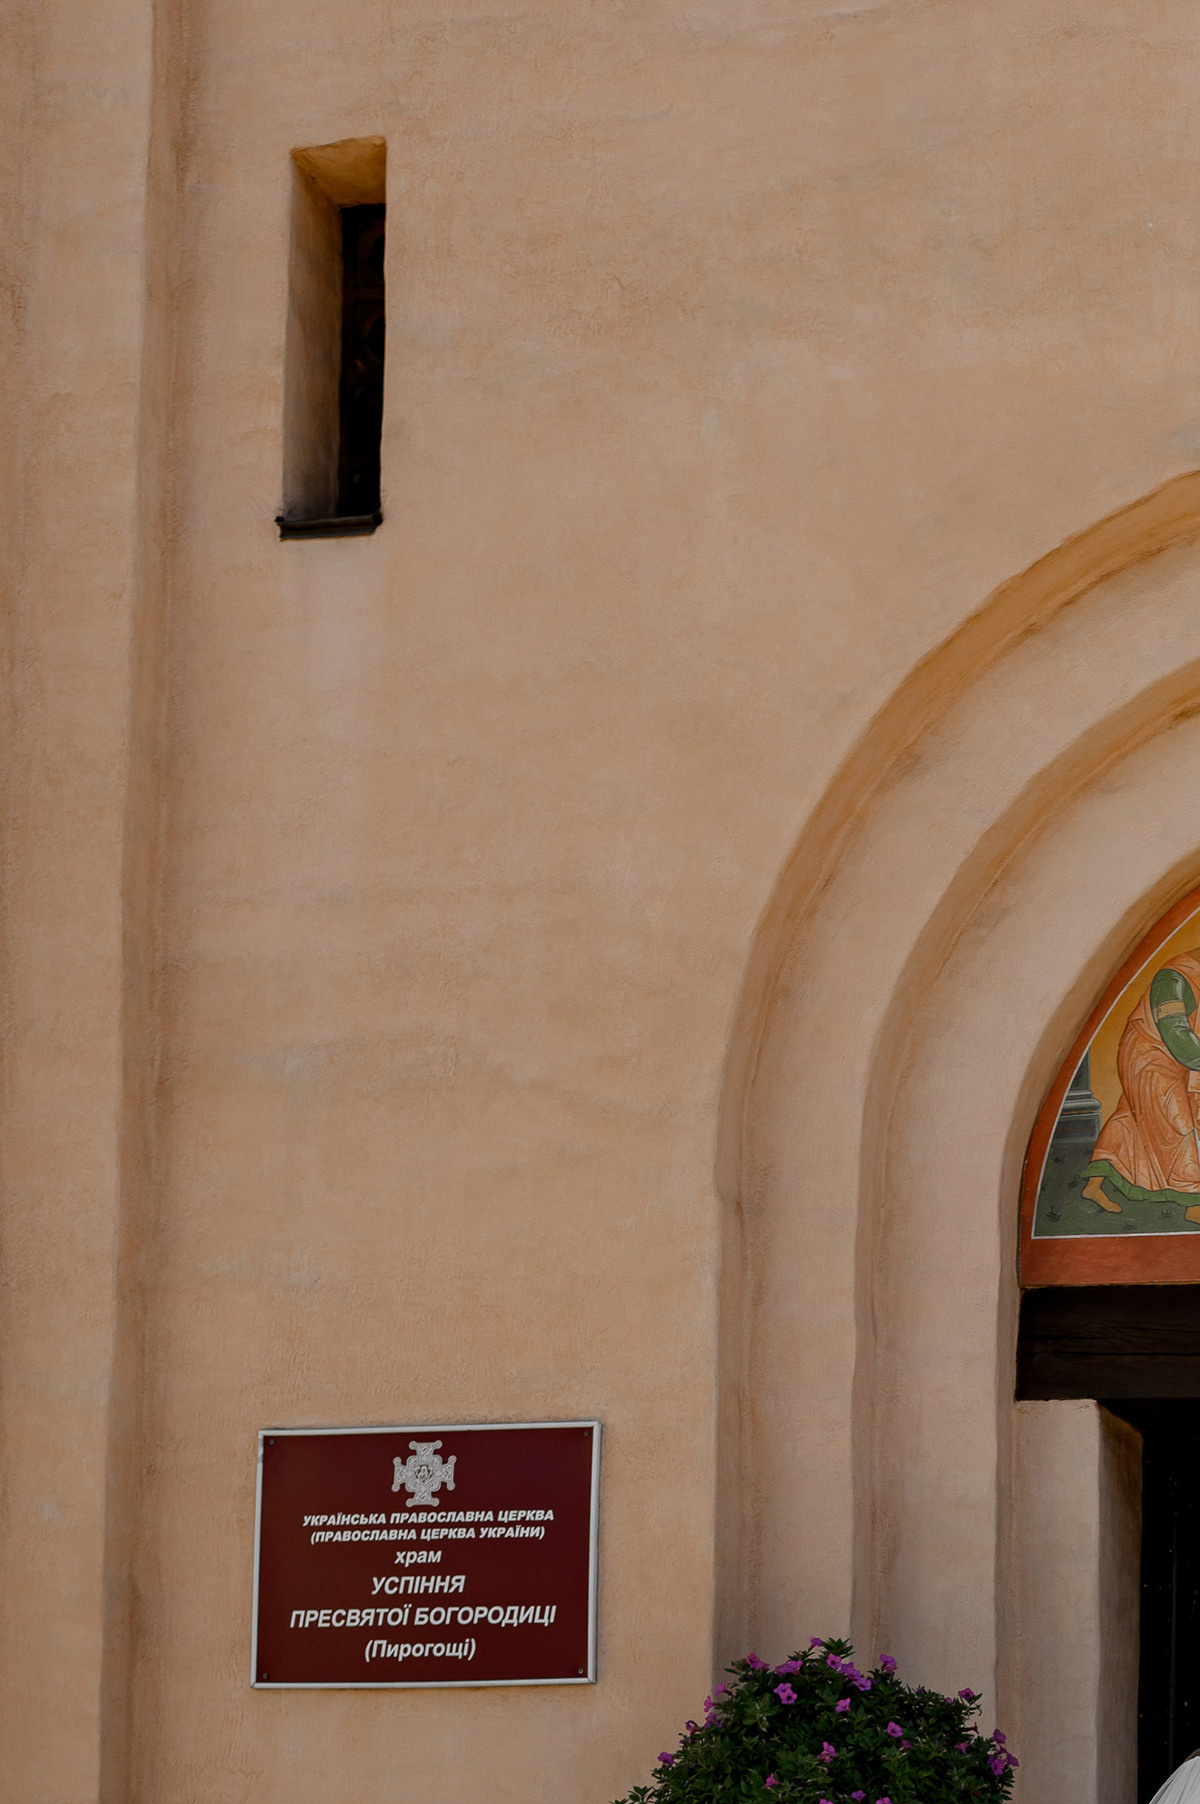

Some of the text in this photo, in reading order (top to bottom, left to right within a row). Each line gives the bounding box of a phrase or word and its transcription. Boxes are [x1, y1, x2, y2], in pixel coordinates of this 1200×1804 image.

[303, 1510, 554, 1526] УКРАЇНСЬКА ПРАВОСЛАВНА ЦЕРКВА
[311, 1525, 545, 1545] (ПРАВОСЛАВНА ЦЕРКВА УКРАЇНИ)
[395, 1551, 441, 1567] храм
[372, 1575, 465, 1594] УСПІННЯ
[290, 1604, 556, 1628] ПРЕСВЯТОЇ БОГОРОДИЦІ
[365, 1638, 475, 1662] (Пирогощі)
